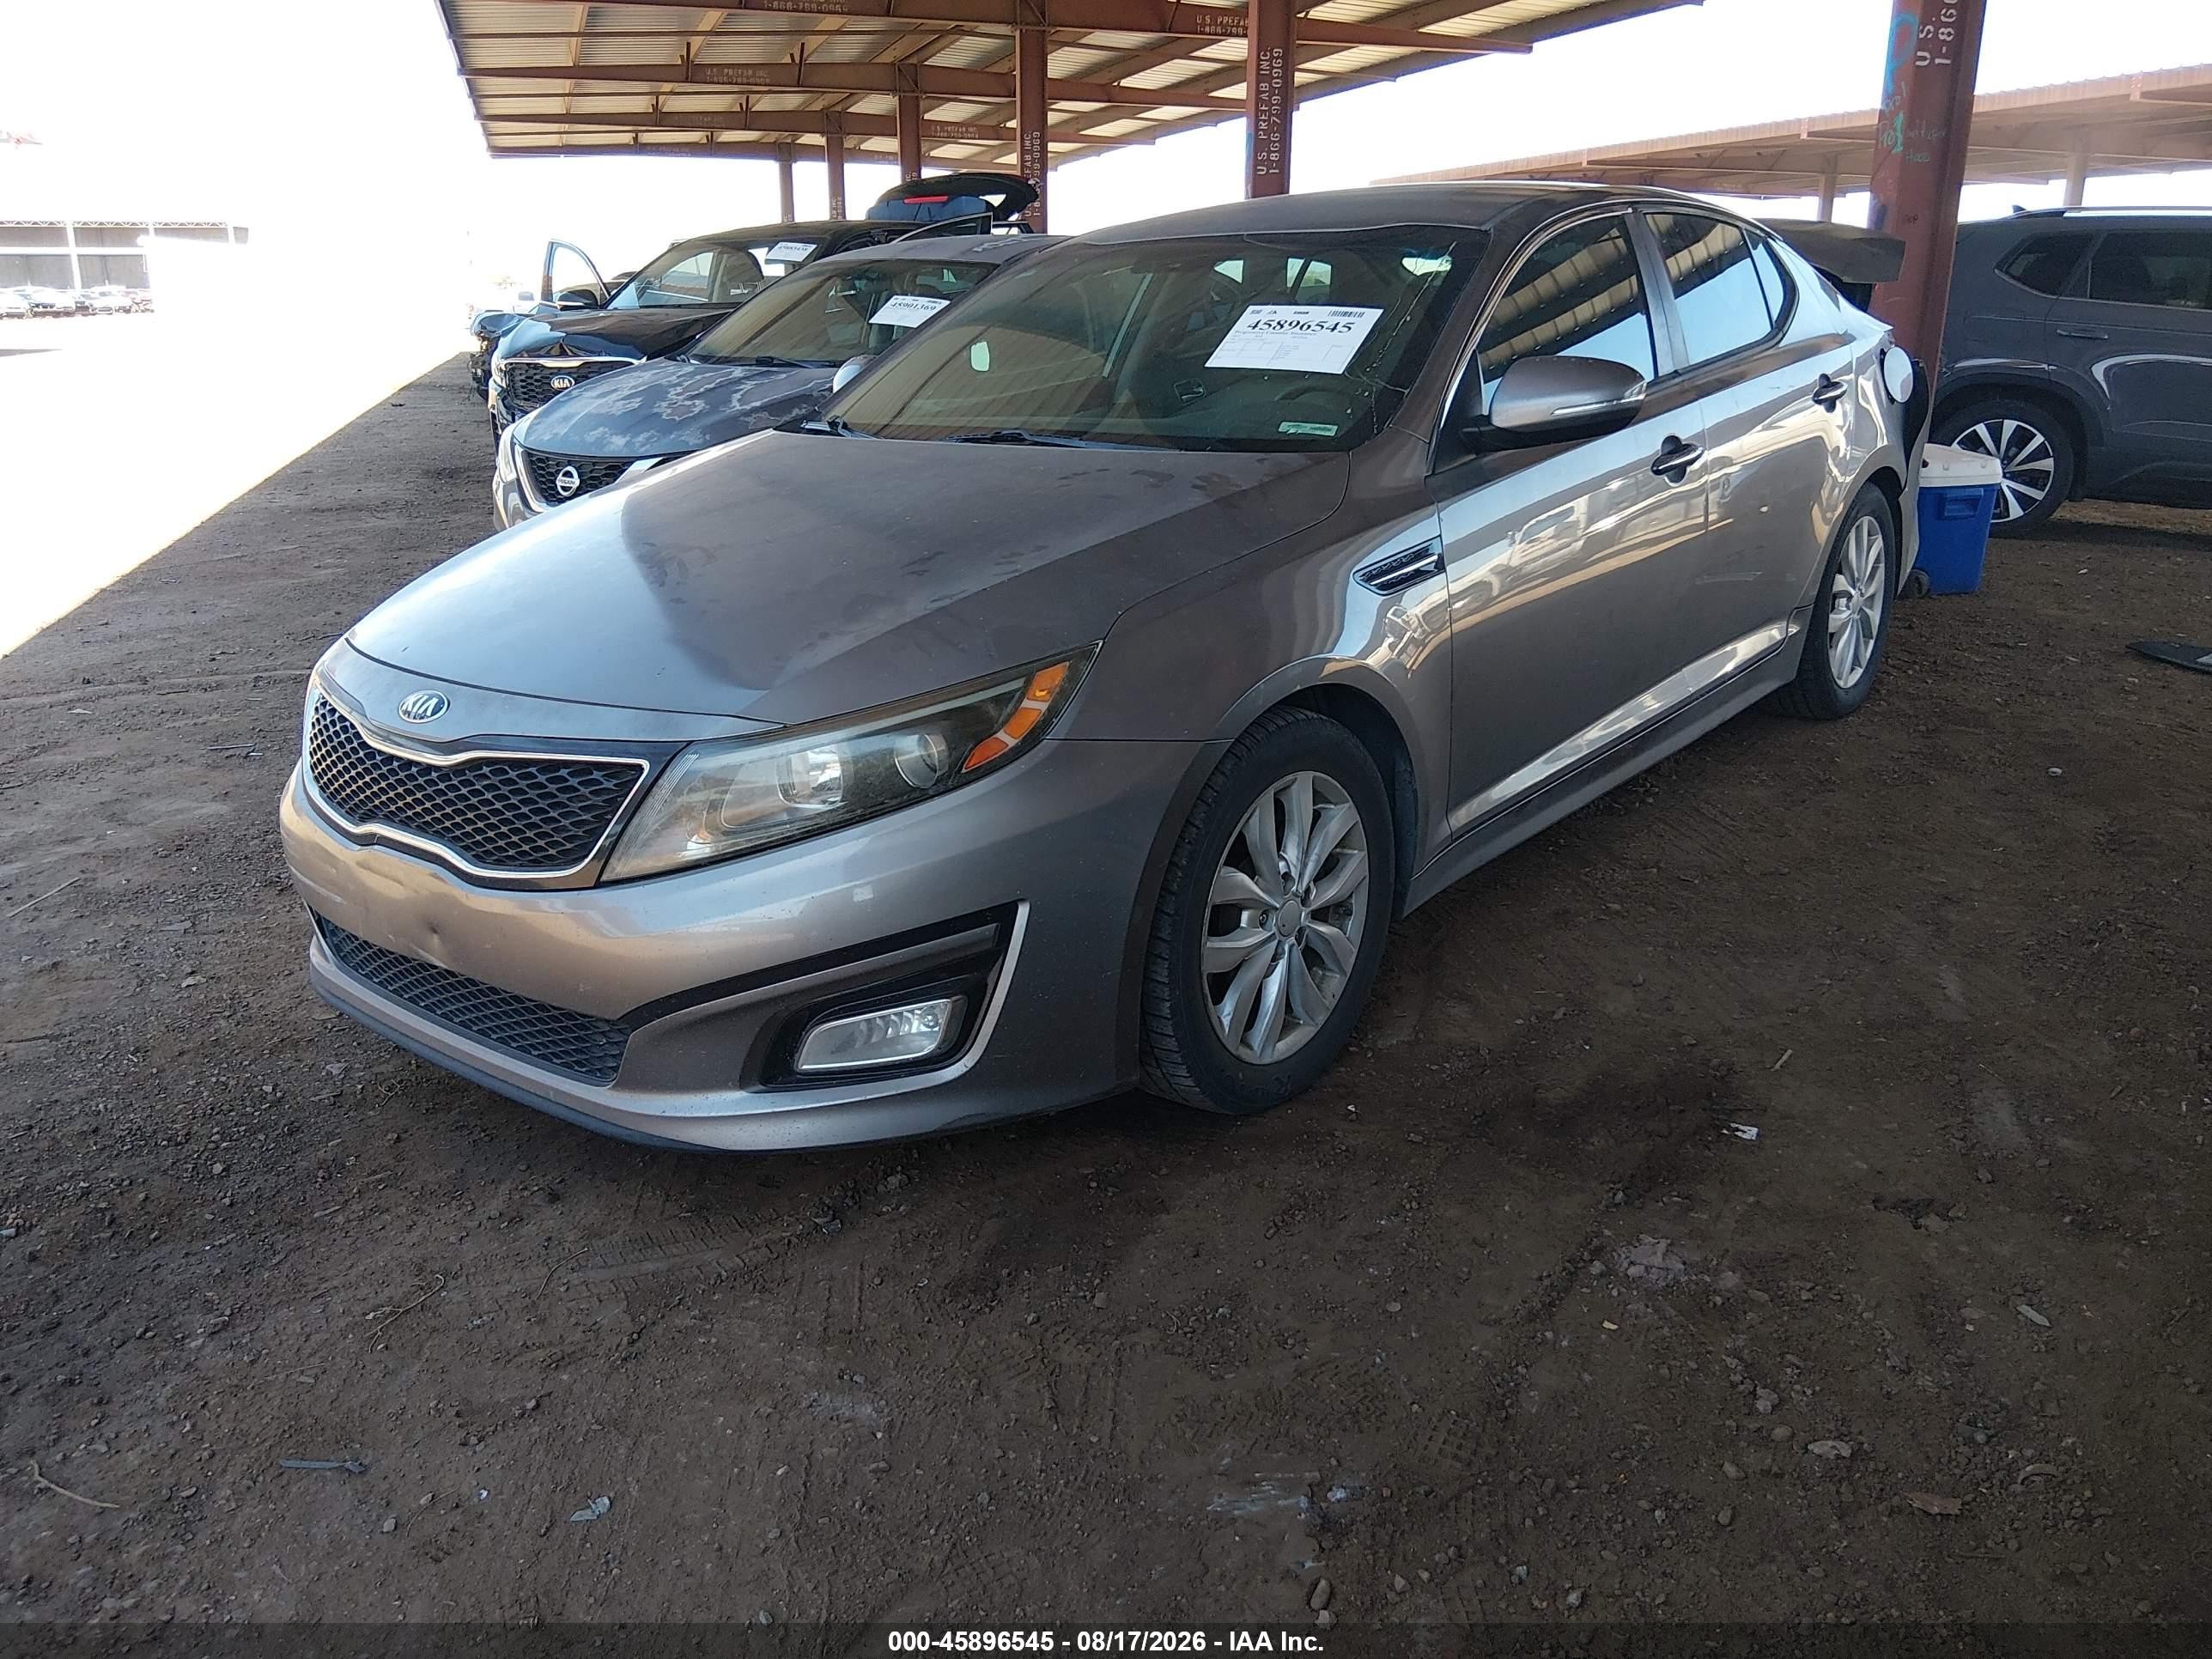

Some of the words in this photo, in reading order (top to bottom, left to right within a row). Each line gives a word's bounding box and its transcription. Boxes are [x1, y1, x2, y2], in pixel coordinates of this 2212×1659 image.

[1259, 46, 1271, 75] INC.
[1257, 82, 1269, 139] PREFAB
[1269, 48, 1283, 174] 1-866-799-0969
[1257, 147, 1268, 175] U.S.
[1247, 319, 1356, 333] 45896545
